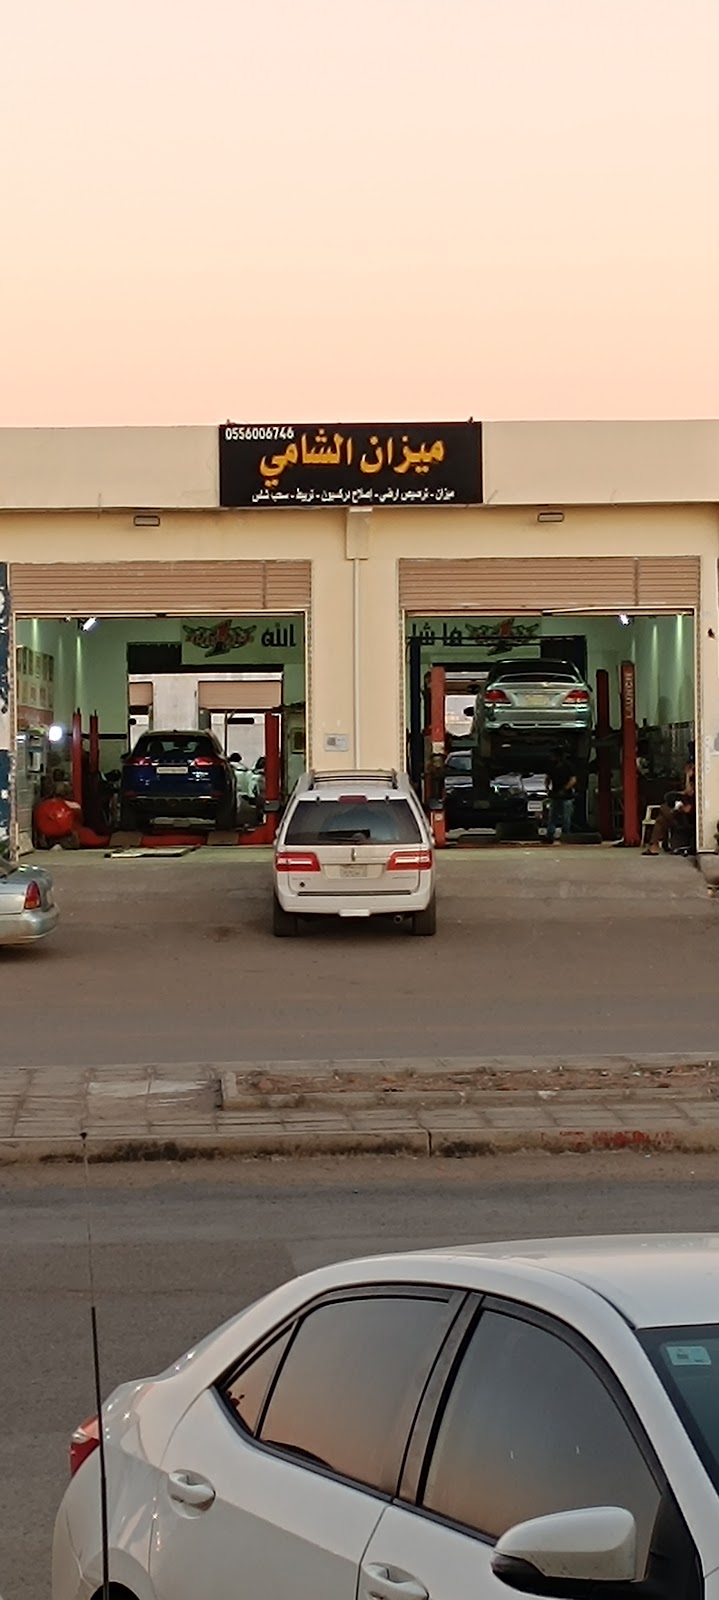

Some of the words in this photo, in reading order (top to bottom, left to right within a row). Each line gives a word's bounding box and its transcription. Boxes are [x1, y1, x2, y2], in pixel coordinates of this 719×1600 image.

[225, 425, 295, 441] 0556006746
[259, 429, 353, 487] الشامي
[360, 435, 446, 474] ميزان
[434, 487, 455, 501] ميزان
[261, 622, 298, 647] الله
